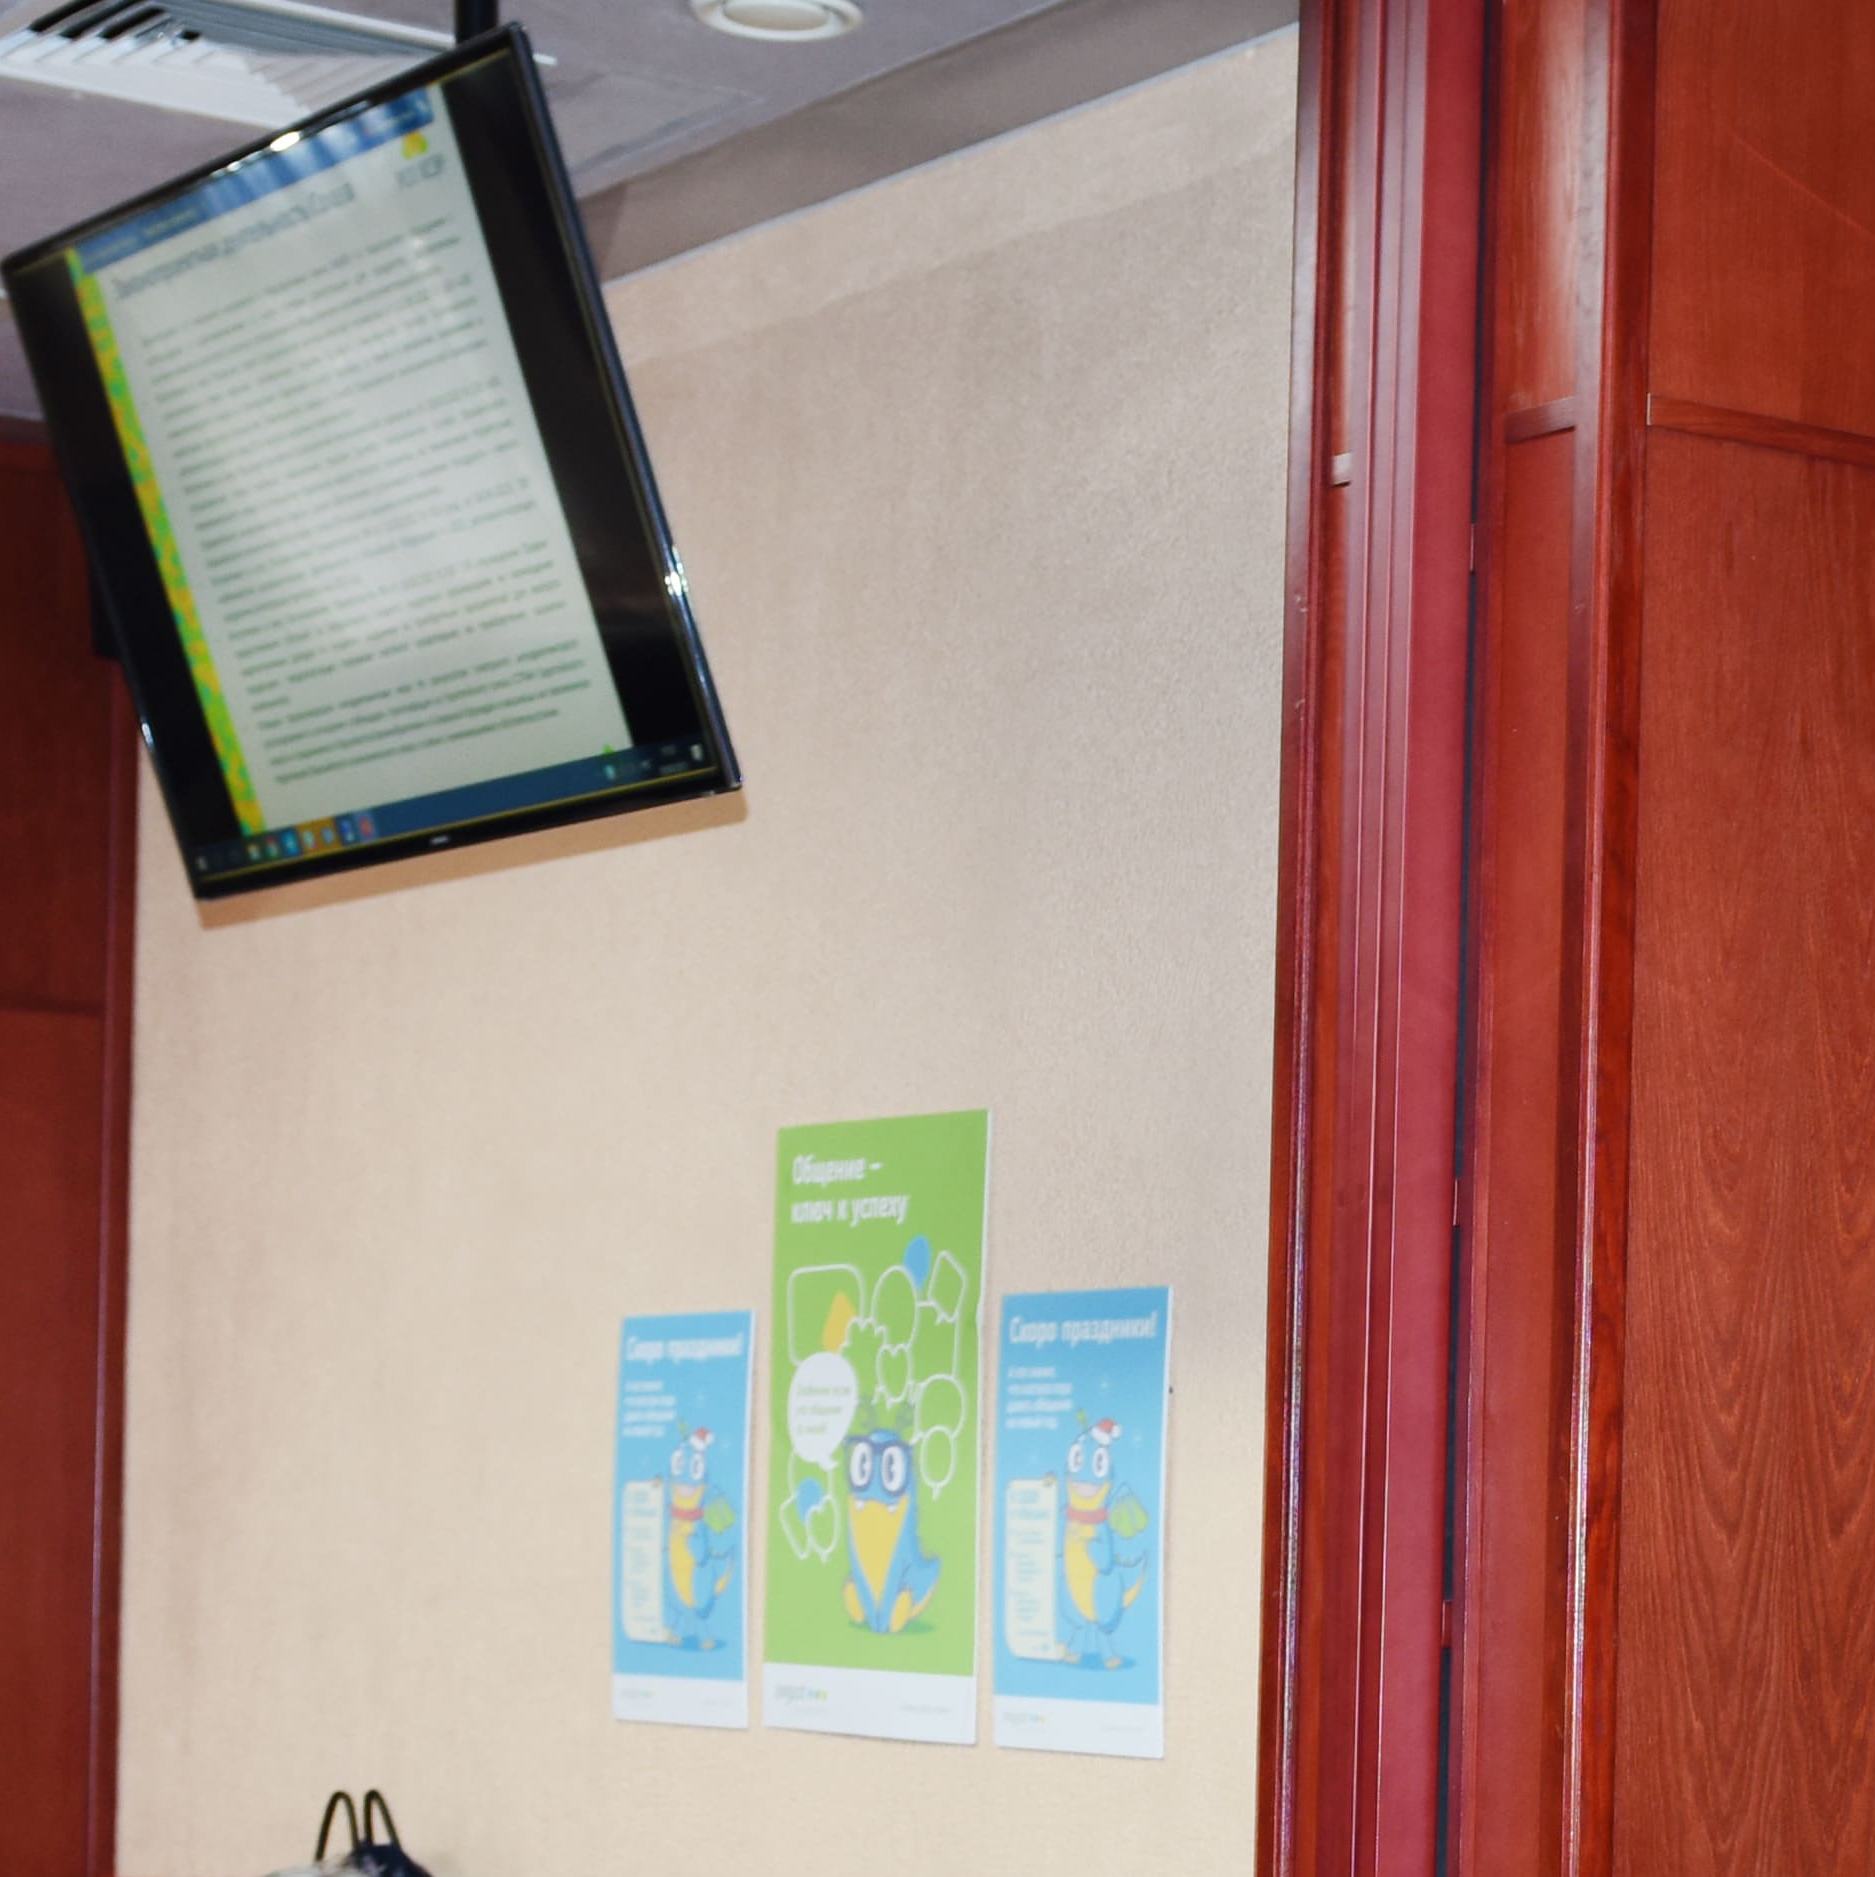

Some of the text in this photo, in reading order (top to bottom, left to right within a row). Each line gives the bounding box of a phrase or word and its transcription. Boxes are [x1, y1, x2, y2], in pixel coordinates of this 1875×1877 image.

[793, 1153, 866, 1188] Общение
[791, 1195, 909, 1227] ключ к успеху
[1010, 1310, 1158, 1349] Скоро праздники!
[627, 1335, 664, 1365] Скоро
